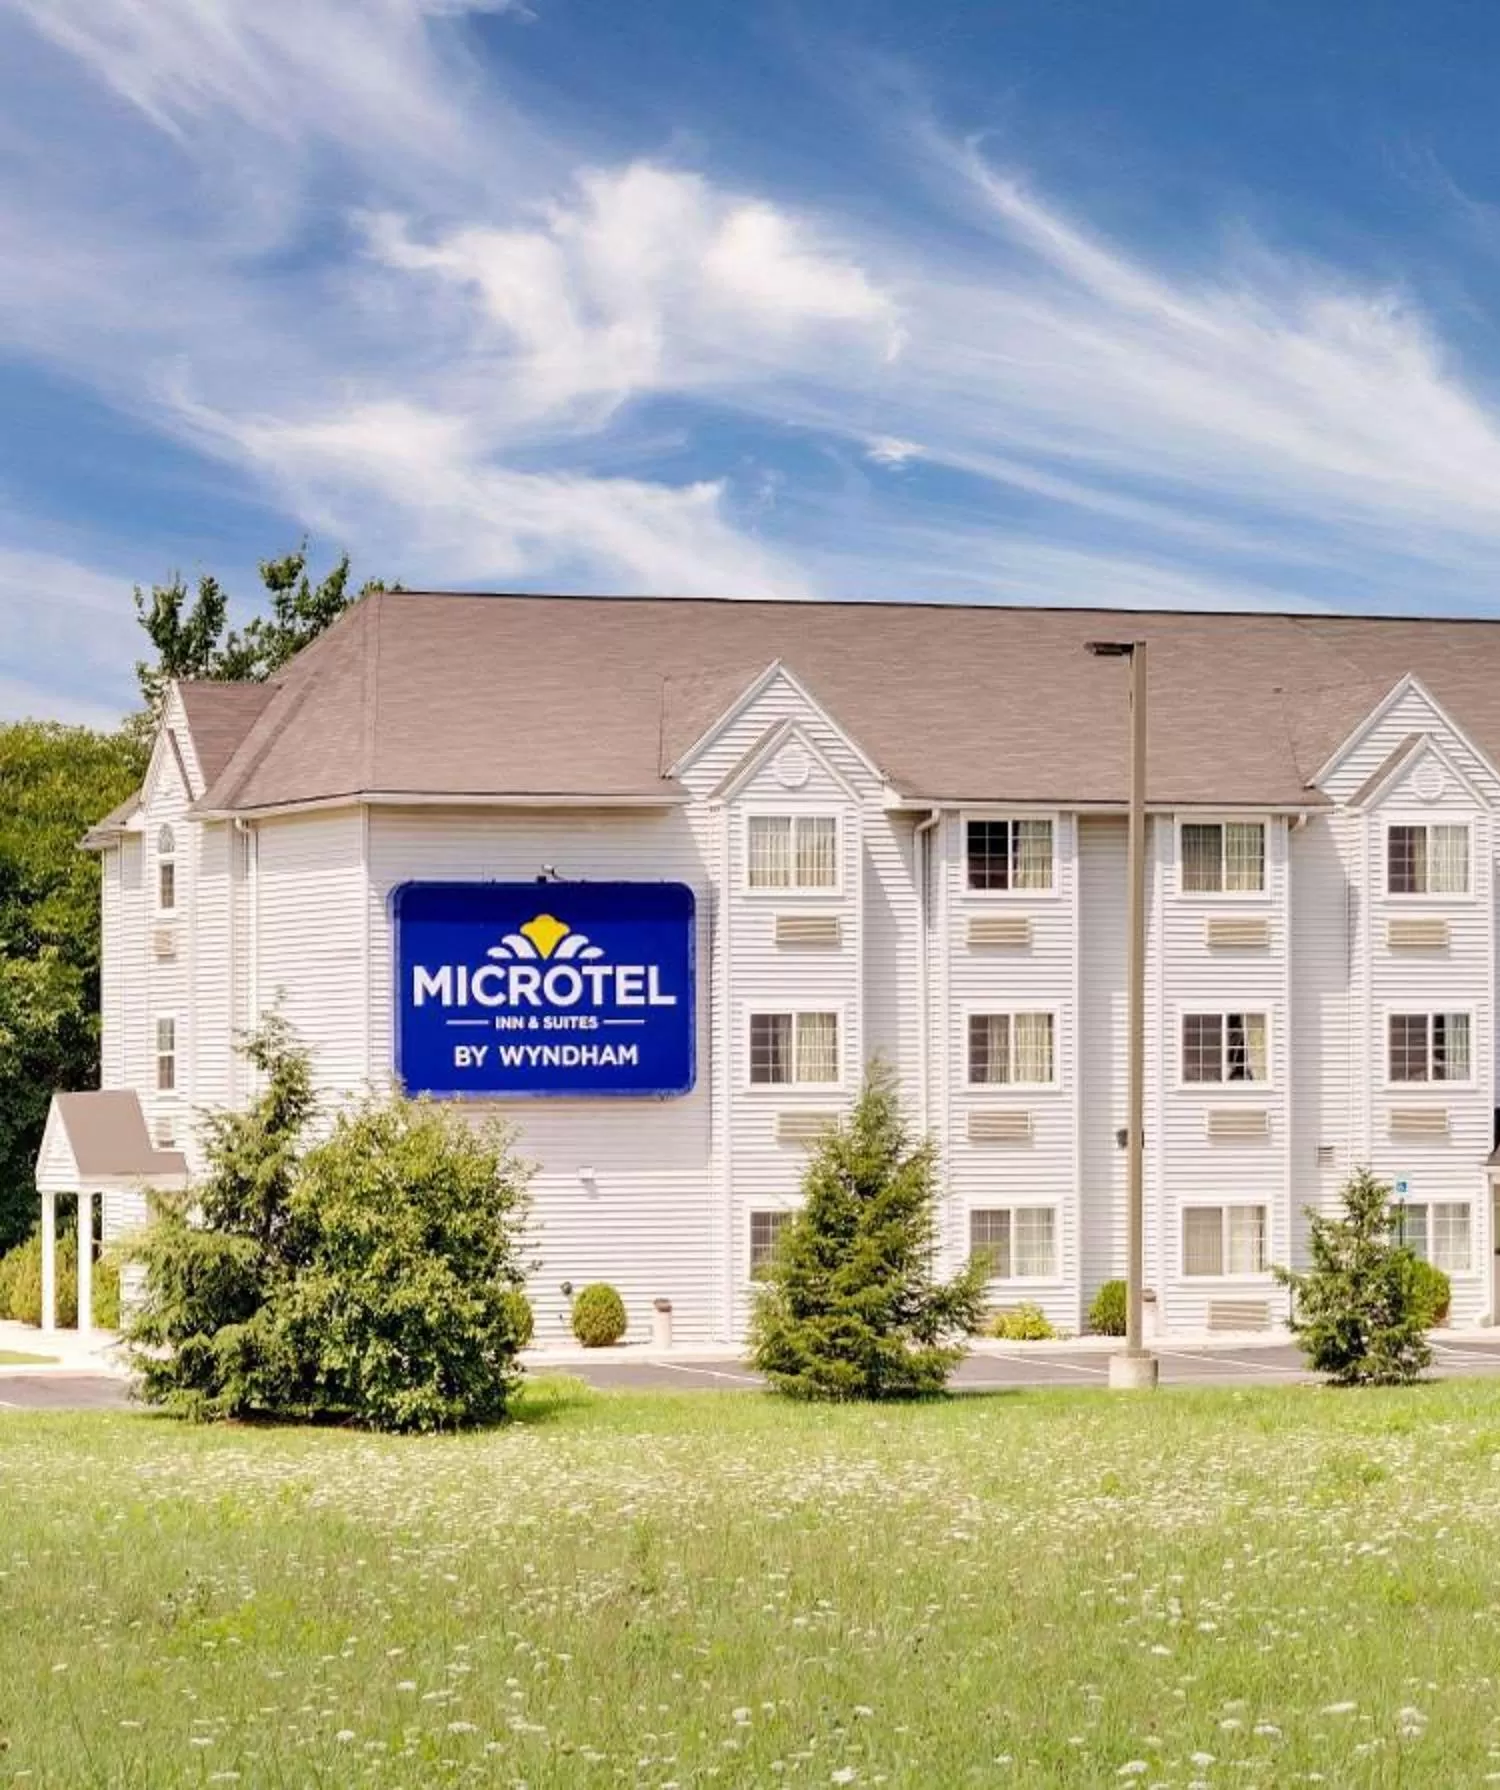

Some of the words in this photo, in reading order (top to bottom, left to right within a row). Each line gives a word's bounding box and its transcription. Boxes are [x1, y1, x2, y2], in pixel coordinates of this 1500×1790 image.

[413, 965, 677, 1007] MICROTEL
[495, 1015, 524, 1030] INN
[528, 1015, 539, 1030] &
[543, 1015, 599, 1030] SUITES
[454, 1045, 488, 1067] BY
[499, 1044, 638, 1067] WYNDHAM
